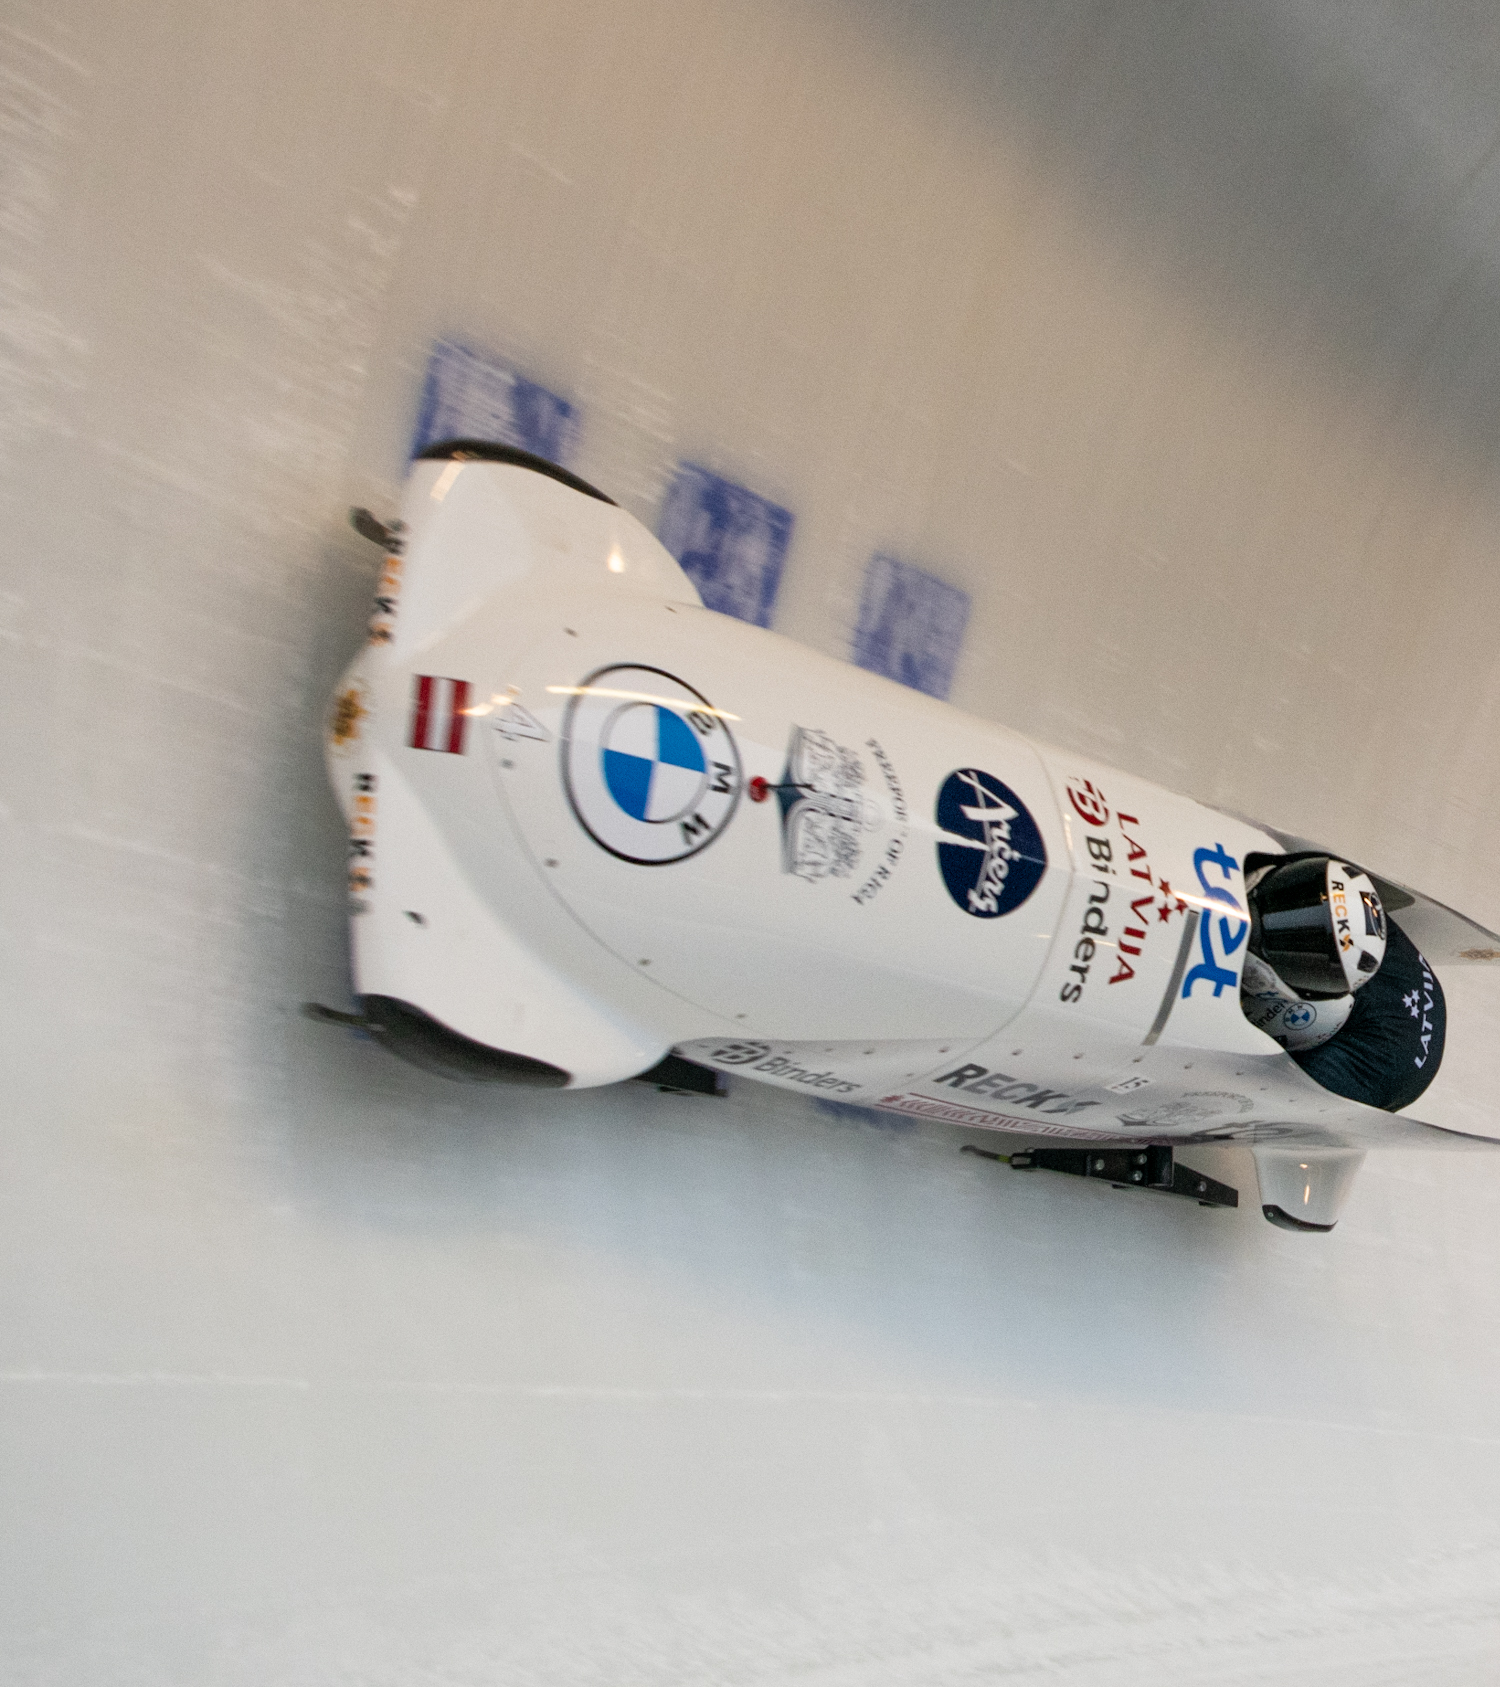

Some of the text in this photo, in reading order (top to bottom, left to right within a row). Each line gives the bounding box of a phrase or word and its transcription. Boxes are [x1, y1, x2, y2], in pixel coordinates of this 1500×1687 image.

[850, 864, 892, 906] RIGA
[1109, 812, 1155, 985] LATVIJA
[1331, 880, 1350, 934] RECK
[1059, 835, 1116, 1004] Binders
[1181, 842, 1250, 1000] tet
[753, 1056, 862, 1094] Binders
[932, 1063, 1065, 1111] RECK
